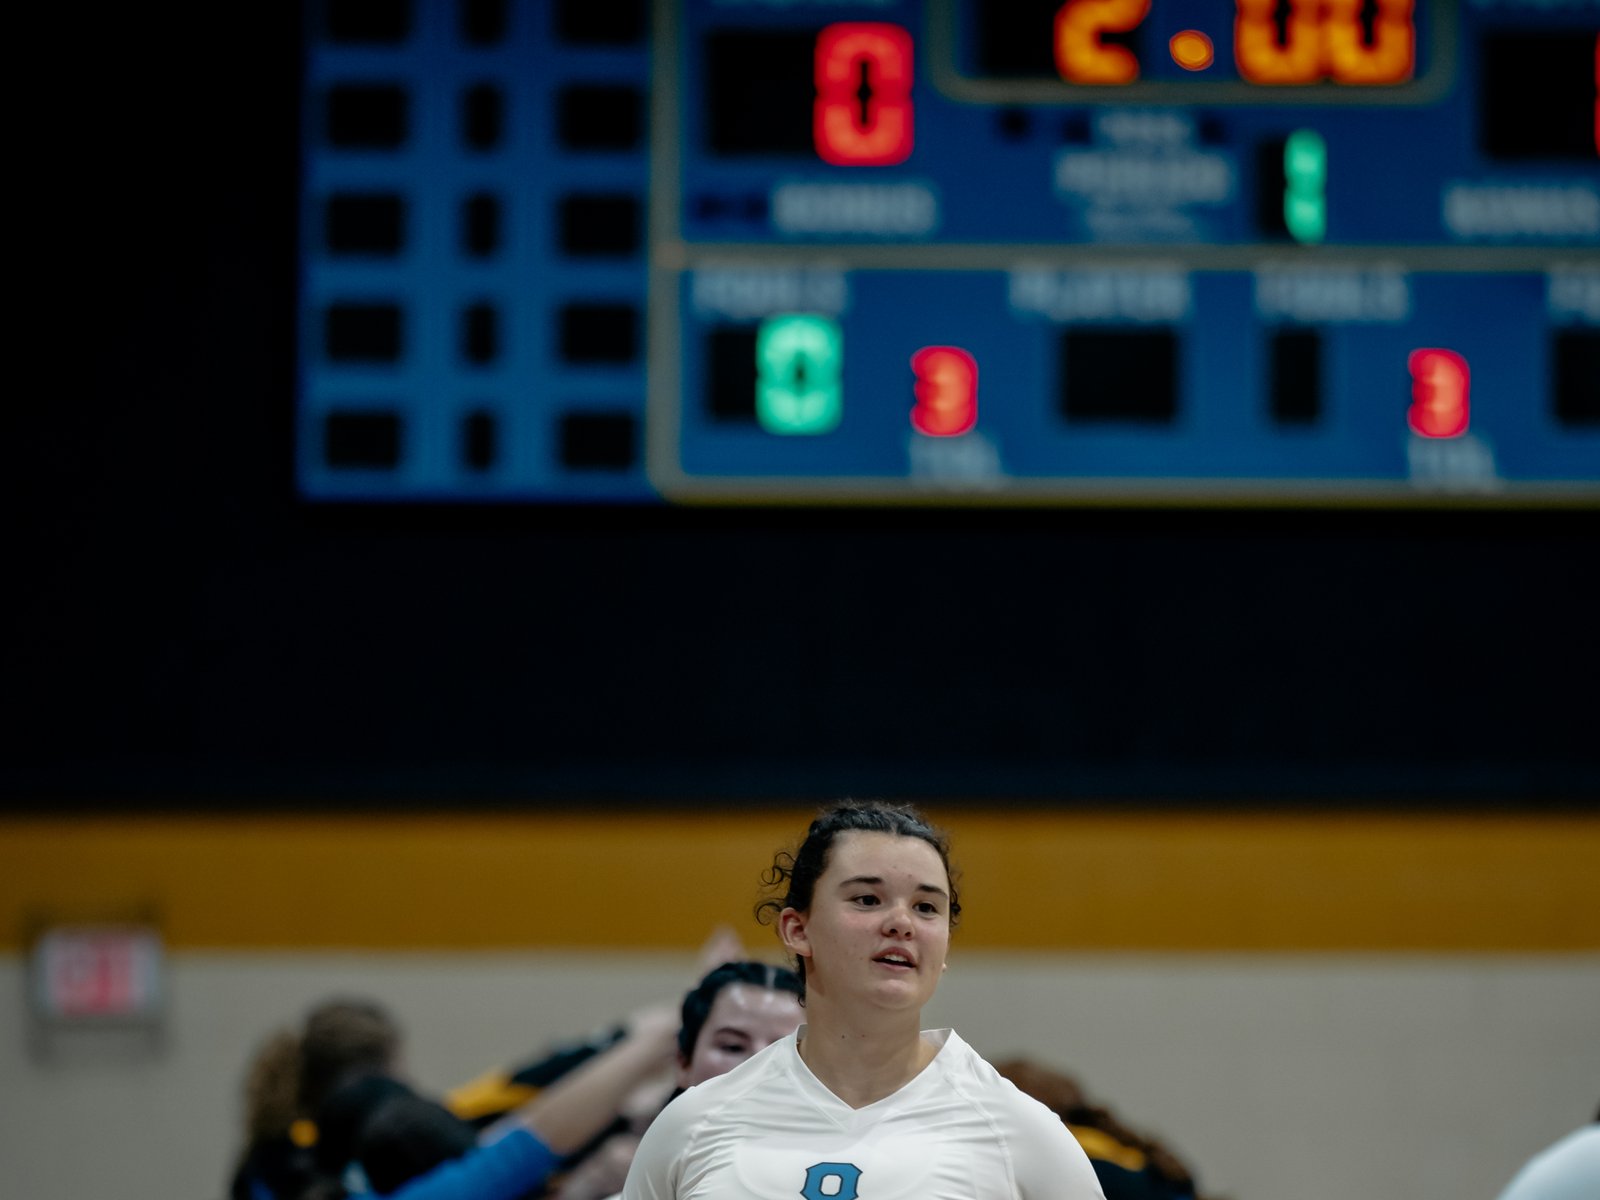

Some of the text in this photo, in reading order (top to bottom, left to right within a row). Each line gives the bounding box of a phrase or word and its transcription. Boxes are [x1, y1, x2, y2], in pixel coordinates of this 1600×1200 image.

[814, 22, 914, 166] 0
[1283, 129, 1327, 245] 1
[756, 315, 844, 436] 0
[910, 345, 979, 437] 3
[1408, 348, 1470, 439] 3
